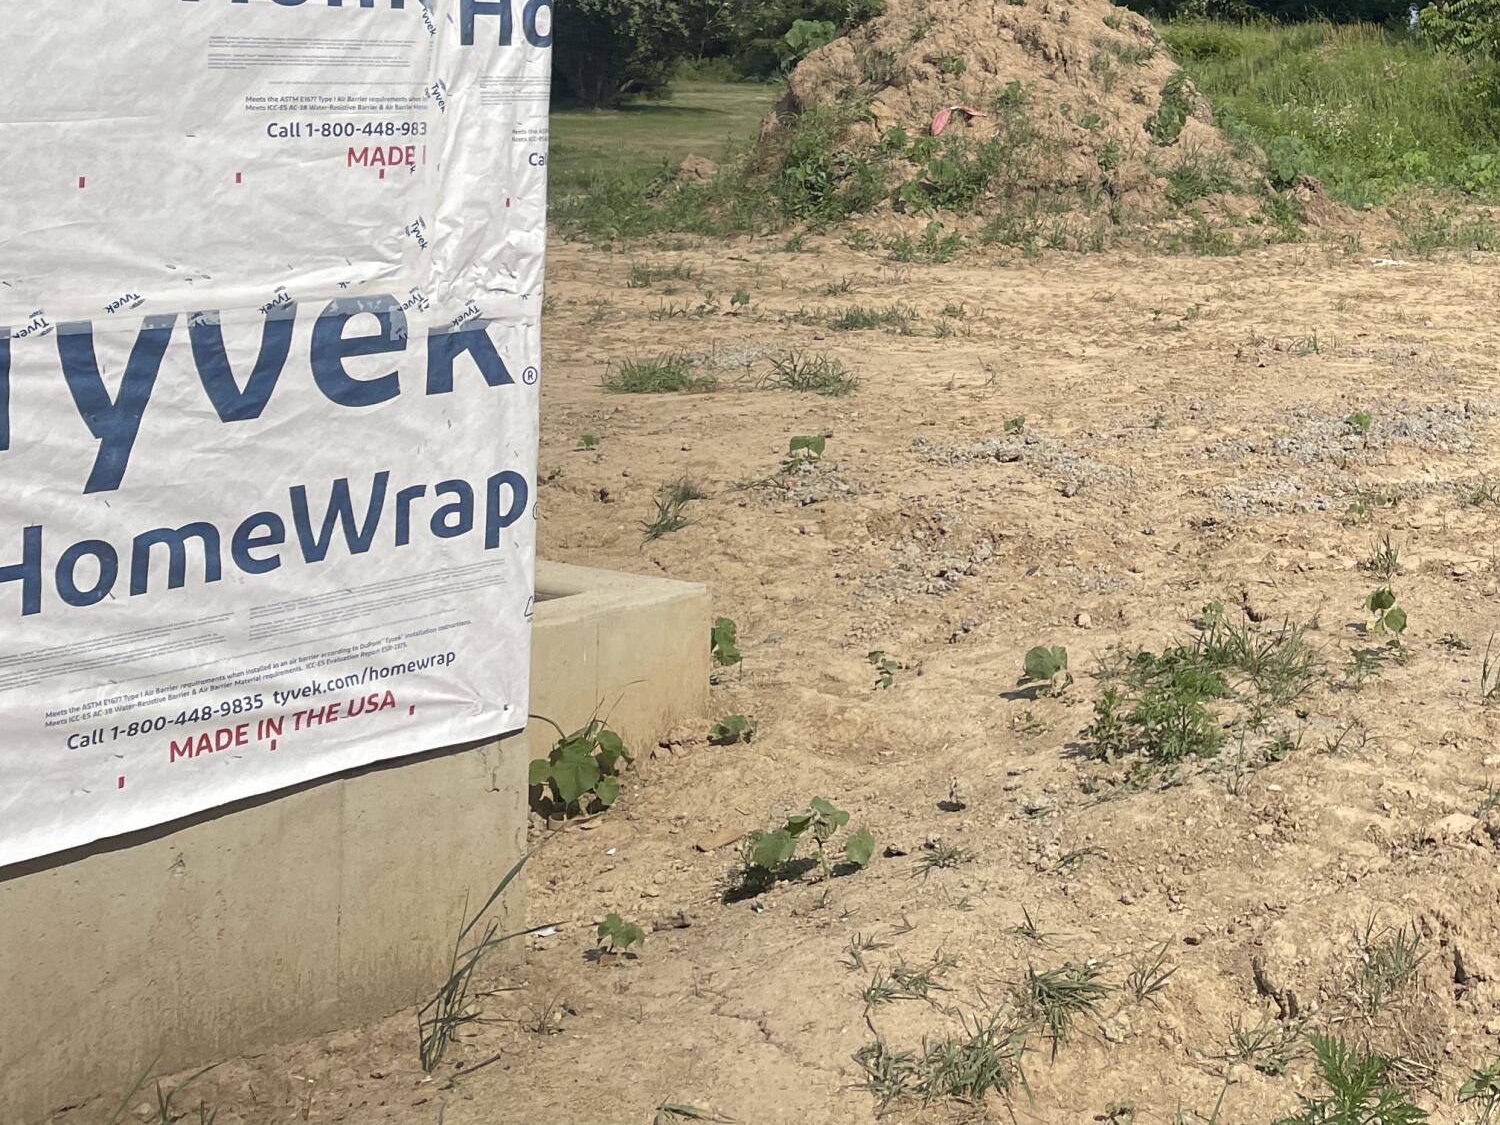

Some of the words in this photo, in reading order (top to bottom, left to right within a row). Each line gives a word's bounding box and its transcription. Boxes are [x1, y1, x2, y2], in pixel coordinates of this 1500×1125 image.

[267, 122, 300, 138] Call
[347, 145, 416, 167] MADE
[410, 220, 428, 251] Tyvek
[103, 291, 141, 314] Tyvek
[257, 291, 292, 315] Tyvek
[451, 304, 481, 327] Tyvek
[45, 708, 68, 718] Meets
[69, 705, 80, 714] the
[82, 701, 102, 711] ASTM
[123, 692, 139, 702] Type
[144, 689, 154, 697] Air
[155, 684, 179, 695] Barrier
[180, 675, 225, 690] requirements
[227, 670, 244, 679] when
[246, 663, 271, 675] installed
[298, 653, 319, 663] barrier
[321, 647, 352, 659] according
[45, 719, 67, 727] Meets
[114, 696, 166, 712] Water-Resistive
[168, 690, 190, 701] Barrier
[199, 686, 208, 694] Air
[210, 681, 233, 692] Barrier
[234, 675, 261, 687] Material
[326, 653, 359, 665] Evaluation
[360, 648, 380, 659] Report
[67, 728, 104, 750] Call
[111, 693, 263, 741] 1-800-448-9835
[273, 651, 456, 707] tyvek.com/homewrap
[169, 723, 250, 763] MADE
[258, 715, 284, 740] IN
[292, 702, 342, 731] THE
[348, 690, 397, 717] USA
